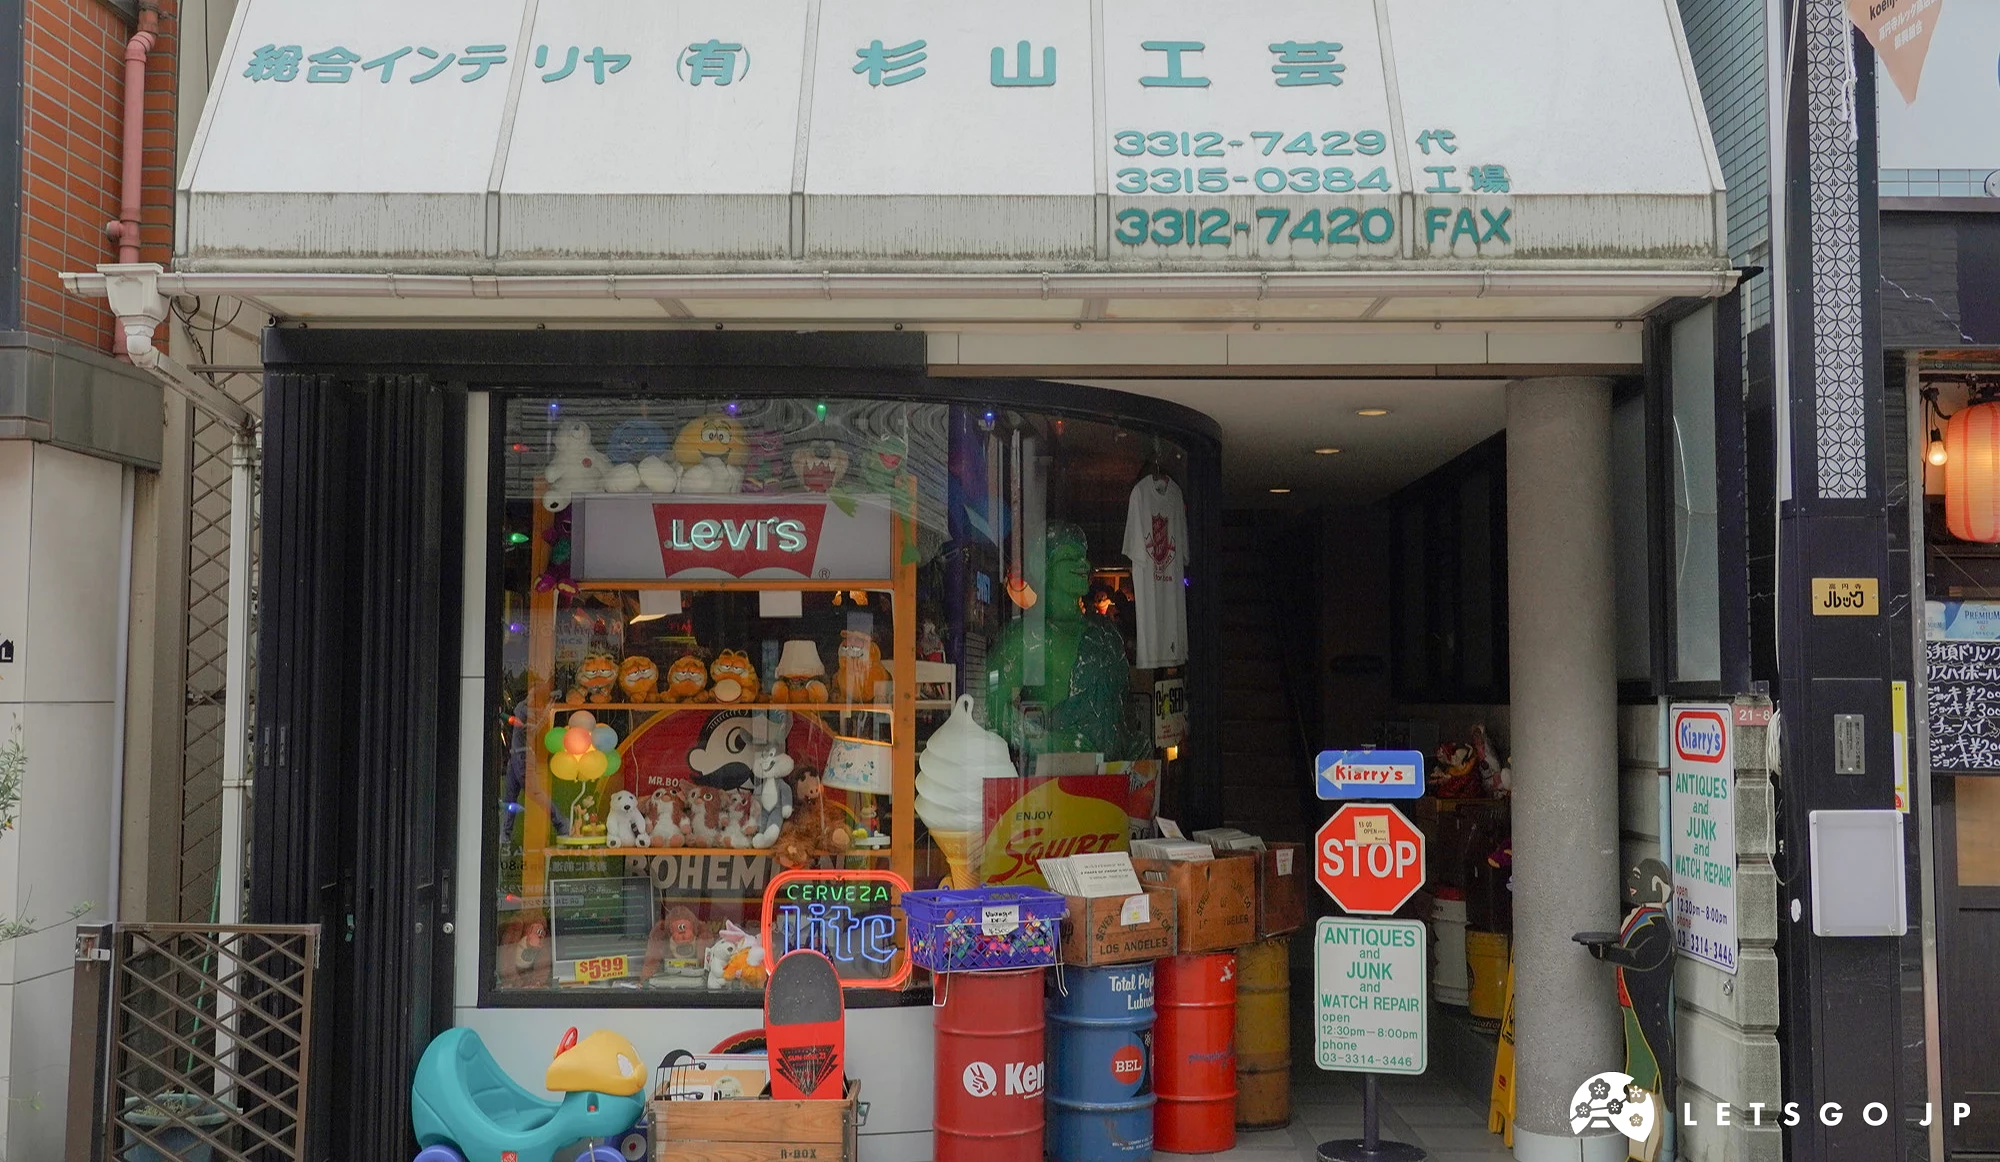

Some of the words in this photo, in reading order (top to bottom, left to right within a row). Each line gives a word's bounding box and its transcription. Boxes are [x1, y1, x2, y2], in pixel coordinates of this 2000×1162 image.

[1113, 130, 1387, 157] 3312-7429
[1416, 129, 1457, 155] 代
[1115, 166, 1392, 194] 3315-0384
[1424, 164, 1511, 194] 工場
[1115, 207, 1395, 245] 3312-7420
[1426, 207, 1512, 244] FAX
[1739, 709, 1771, 722] 21-8
[1675, 772, 1728, 799] ANTIQUES
[1016, 811, 1053, 821] ENJOY
[1692, 800, 1709, 816] and
[1686, 816, 1717, 841] JUNK
[1693, 841, 1710, 857] and
[1322, 838, 1417, 878] STOP
[1675, 854, 1701, 880] WATCH
[1703, 864, 1732, 889] REPAIR
[787, 884, 889, 901] CERVEZA
[1675, 885, 1689, 897] open
[1676, 914, 1691, 930] phone
[1324, 927, 1415, 947] ANTIQUES
[1100, 943, 1119, 955] LOS
[1359, 948, 1380, 959] and
[1346, 962, 1393, 980] JUNK
[1109, 974, 1137, 992] Total
[1359, 982, 1381, 993] and
[1321, 994, 1368, 1010] WATCH
[1373, 996, 1419, 1012] REPAIR
[1322, 1013, 1350, 1023] open
[1322, 1039, 1357, 1050] phone
[1115, 1058, 1142, 1073] BEL
[1322, 1053, 1412, 1066] 03-3314-3446
